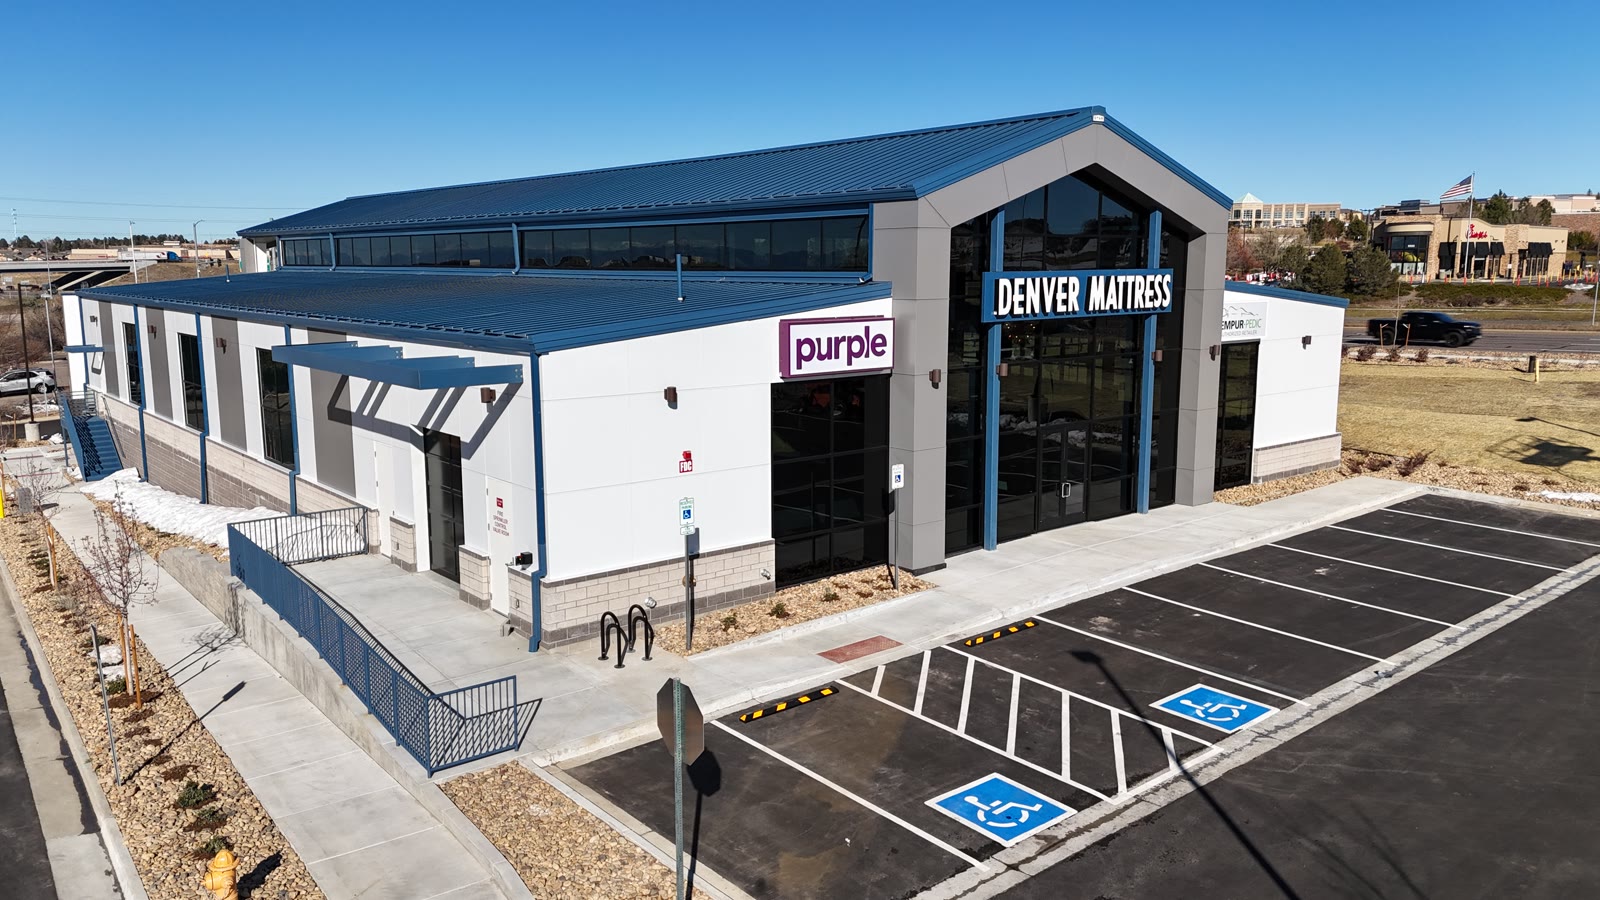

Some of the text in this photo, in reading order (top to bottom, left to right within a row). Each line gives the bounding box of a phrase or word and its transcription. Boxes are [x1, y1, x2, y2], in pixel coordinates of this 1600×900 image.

[994, 274, 1171, 316] DENVER MATTRESS
[796, 325, 887, 370] purple
[680, 461, 692, 472] FDC
